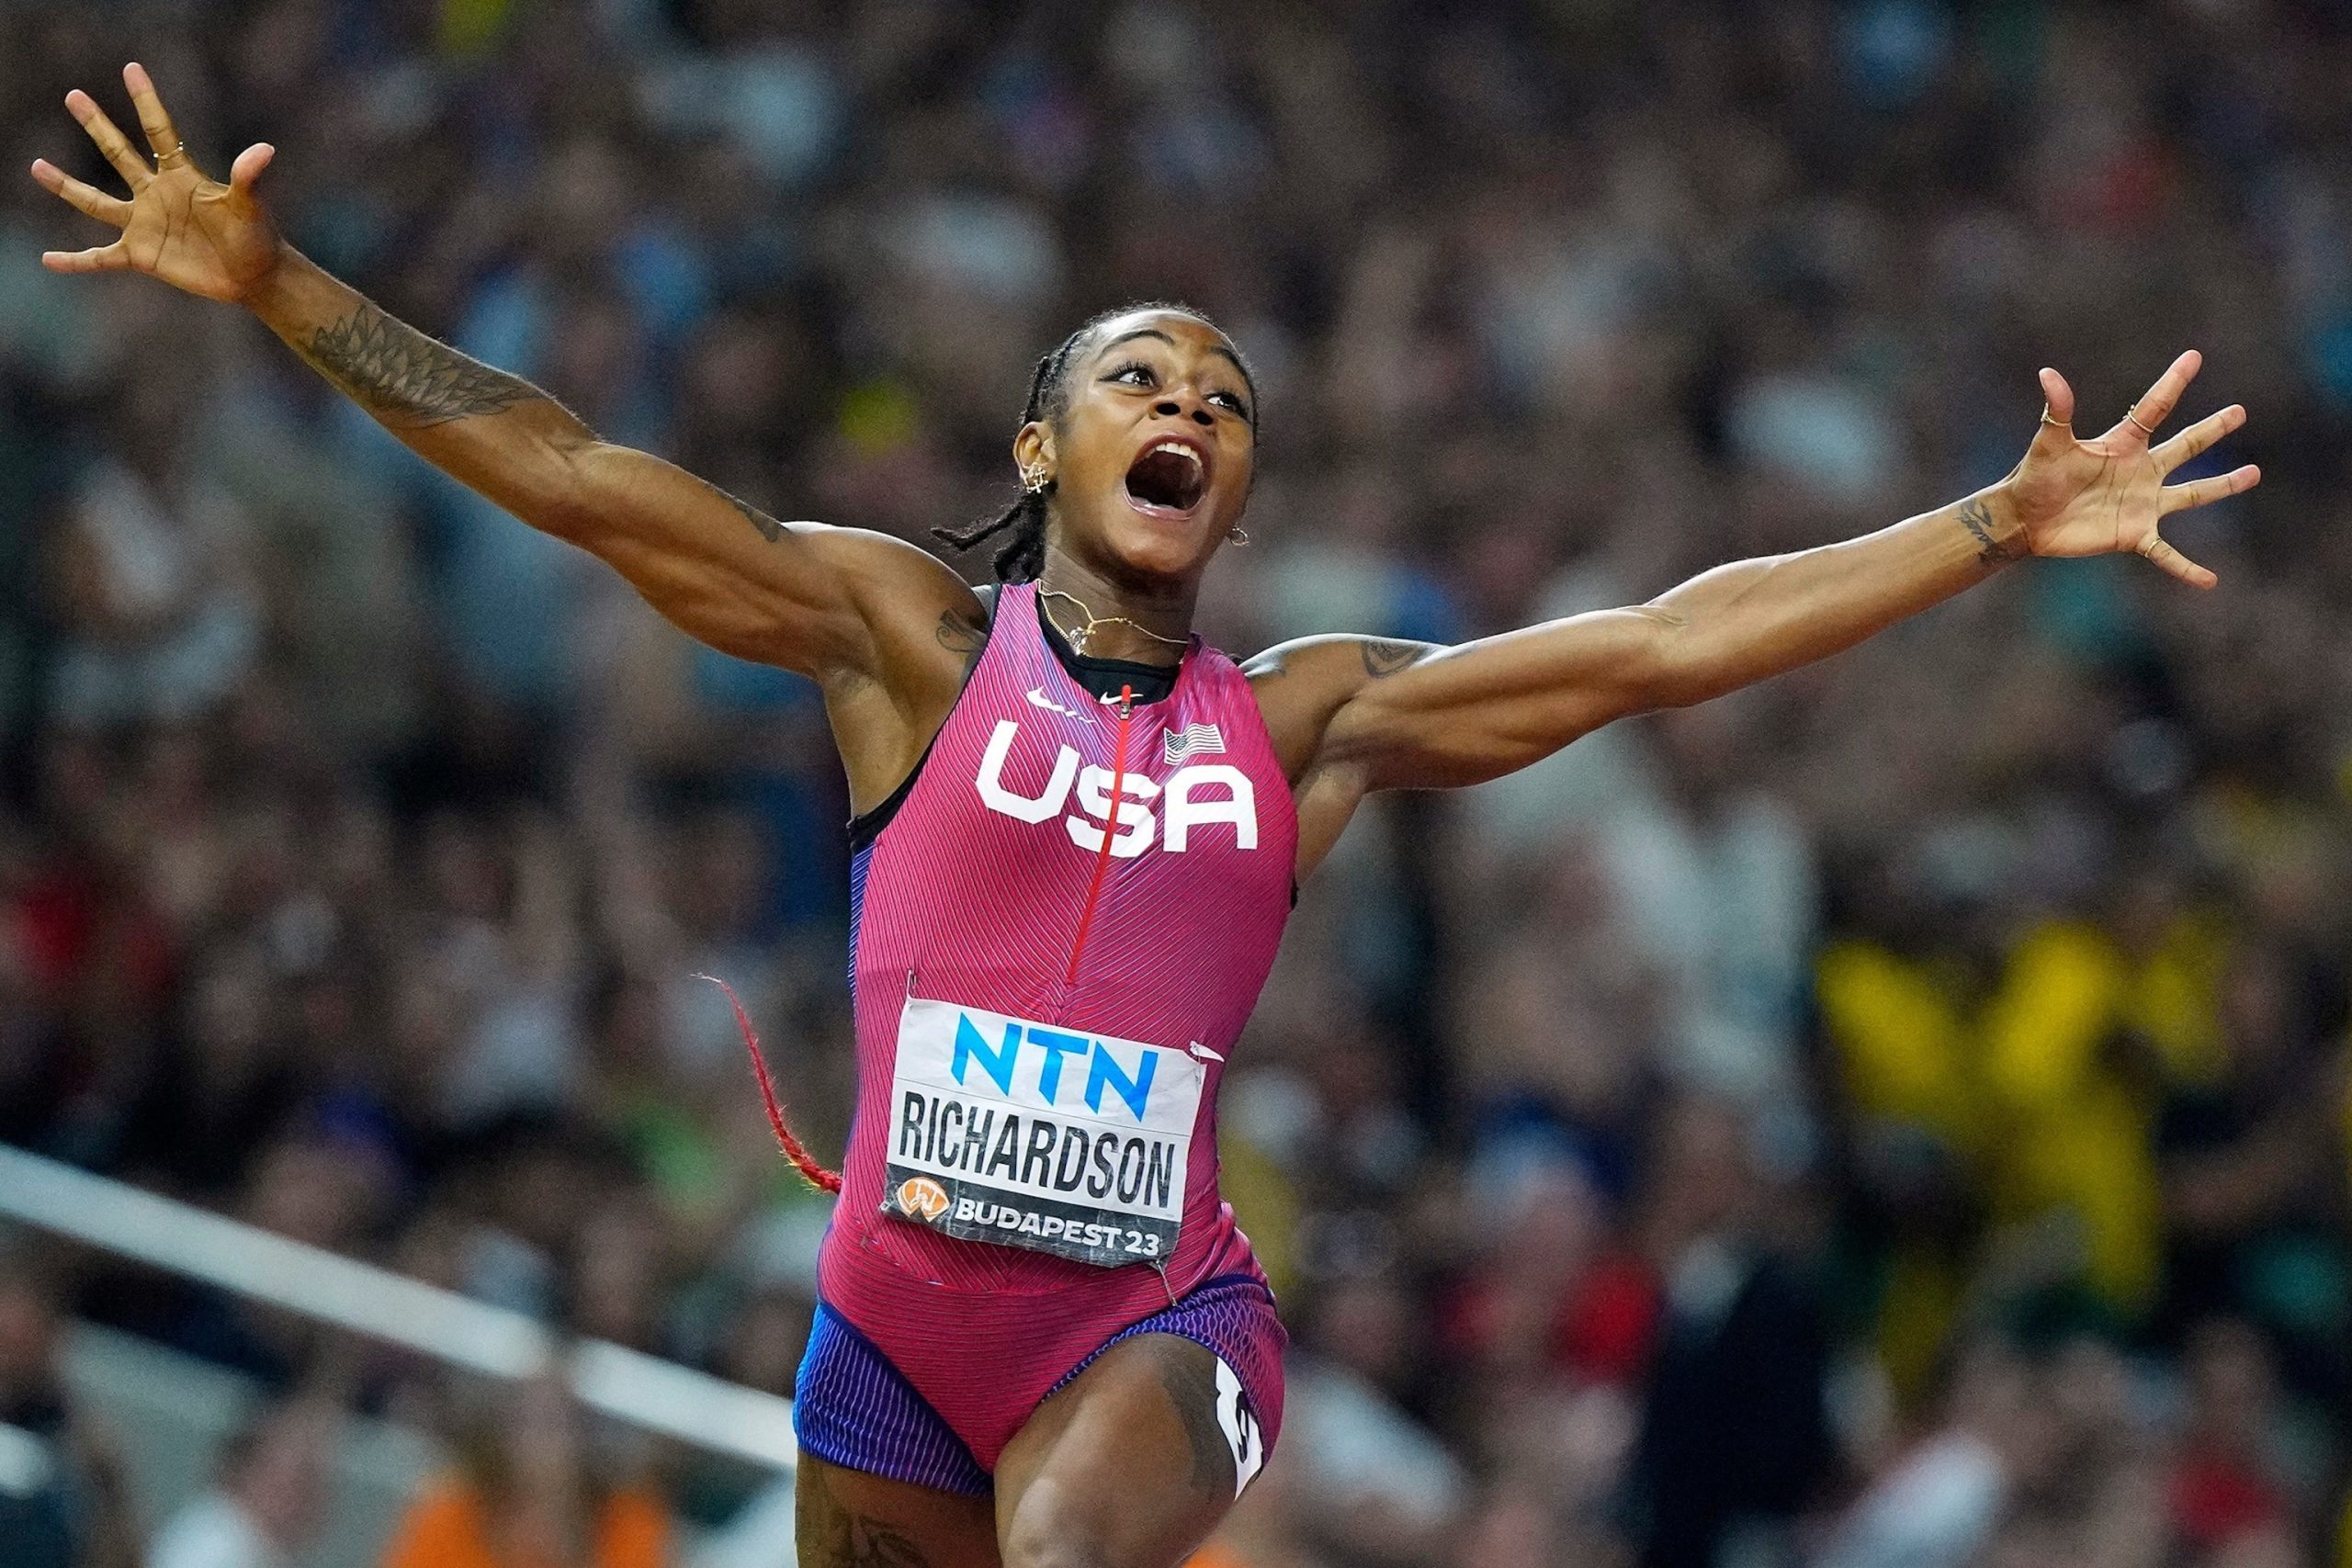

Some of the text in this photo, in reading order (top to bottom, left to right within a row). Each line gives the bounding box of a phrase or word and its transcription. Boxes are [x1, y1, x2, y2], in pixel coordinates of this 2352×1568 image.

[975, 719, 1259, 859] USA
[951, 1011, 1159, 1122] NTN
[899, 1090, 1175, 1209] RICHARDSON
[954, 1197, 1160, 1256] BUDAPEST 23
